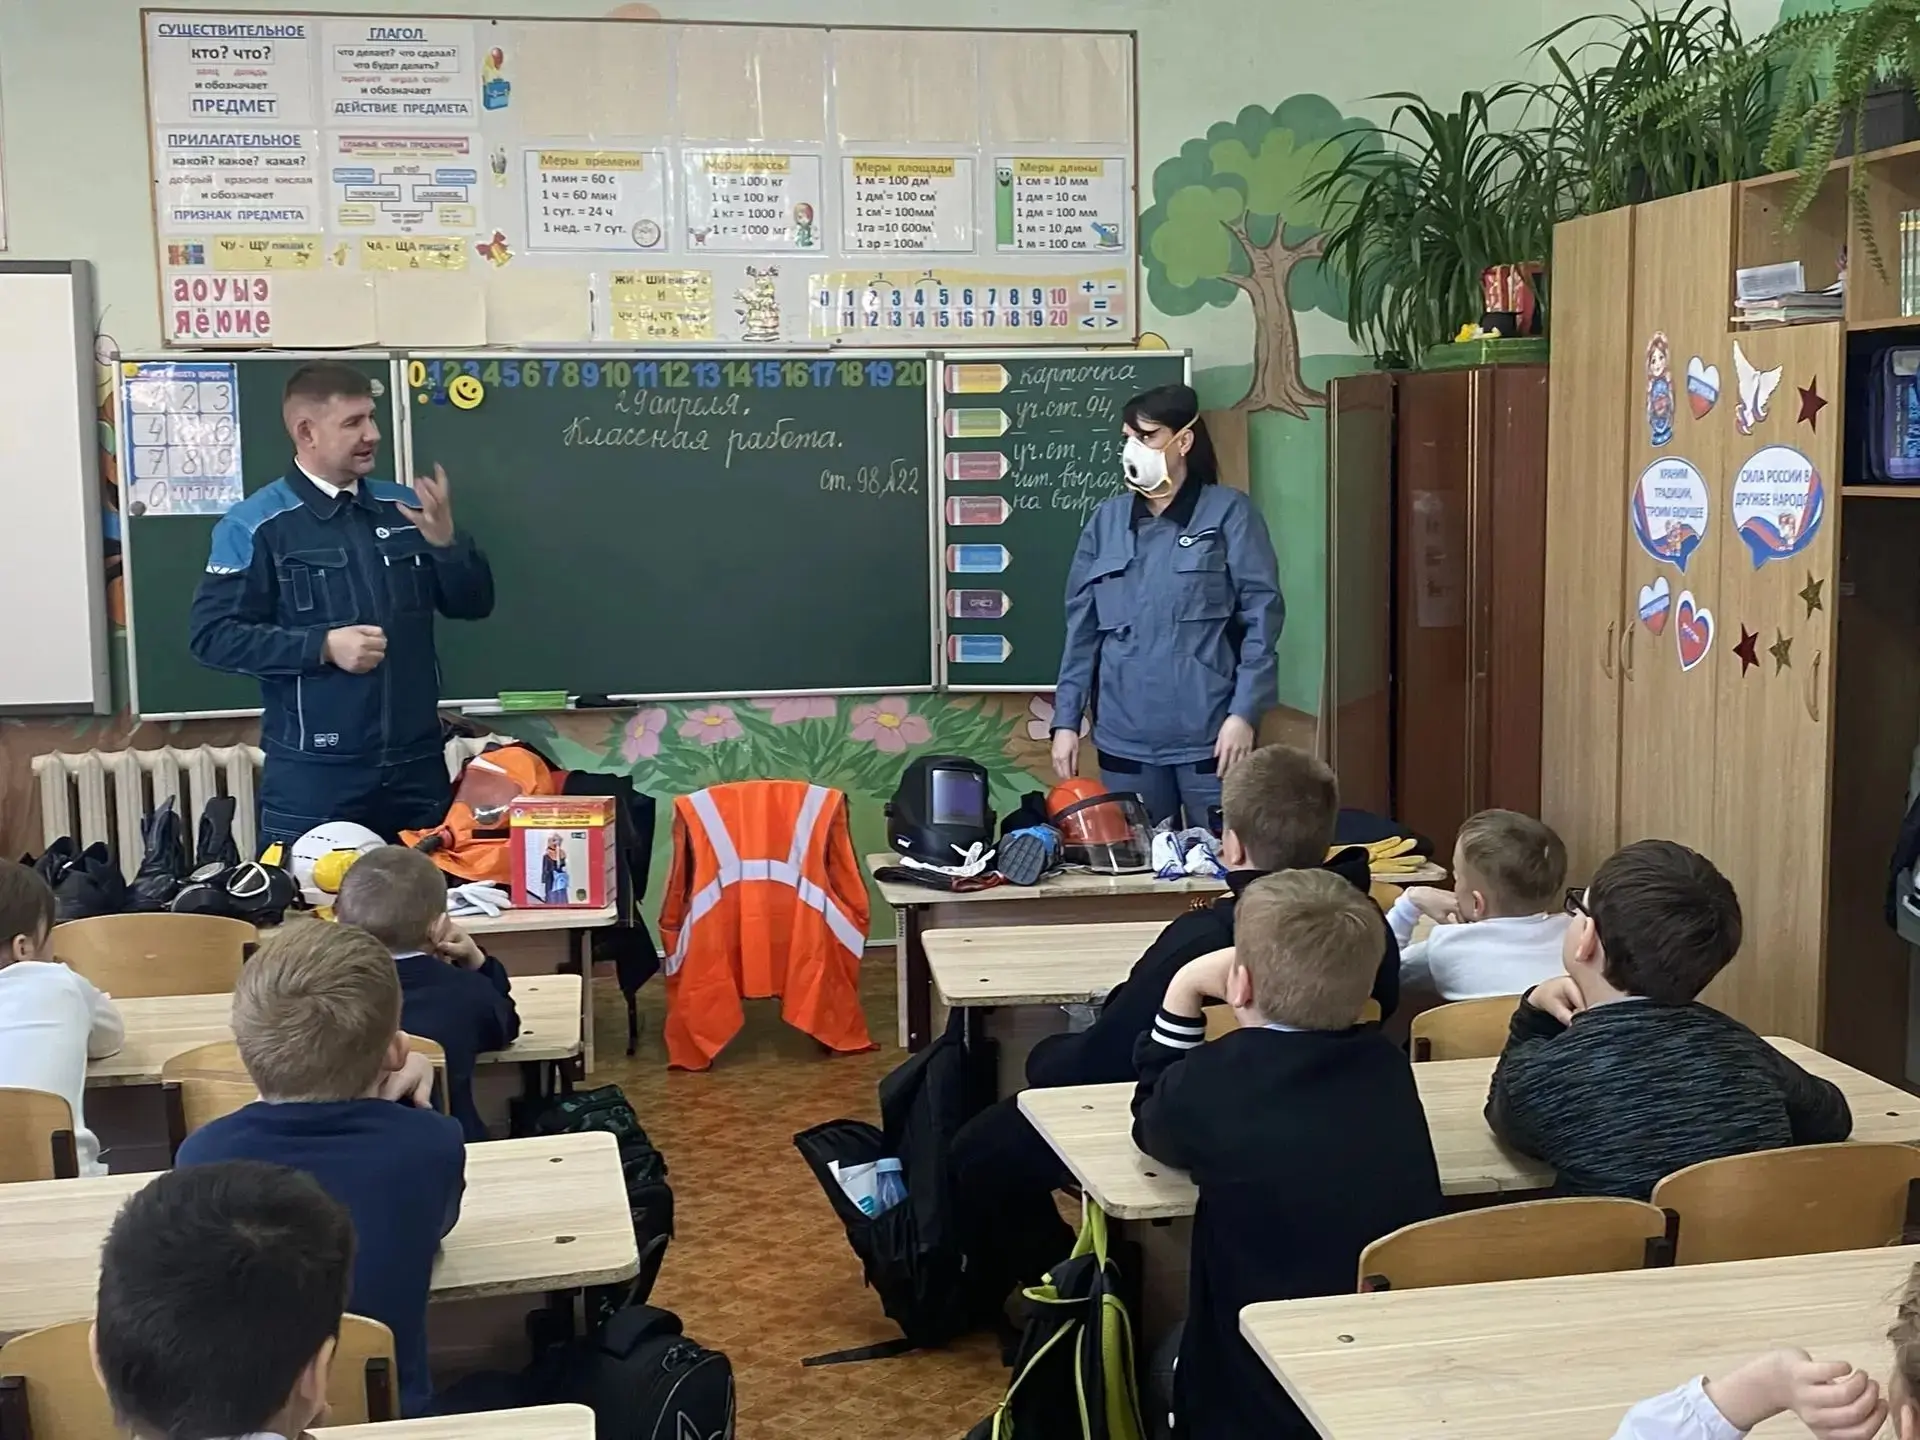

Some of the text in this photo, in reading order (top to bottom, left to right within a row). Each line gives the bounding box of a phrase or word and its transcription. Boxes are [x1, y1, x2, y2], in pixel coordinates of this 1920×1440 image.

[158, 23, 305, 38] СУЩЕСТВИТЕЛЬНОЕ
[370, 28, 423, 39] ГЛАГОЛ
[192, 46, 271, 60] кто? что?
[205, 81, 268, 90] обозначает
[370, 85, 431, 95] обозначает
[192, 99, 276, 114] ПРЕДМЕТ
[335, 102, 468, 115] ДЕЙСТВИЕ ПРЕДМЕТА
[168, 134, 300, 146] ПРИЛАГАТЕЛЬНОЕ
[173, 156, 306, 166] какой? какое? какая?
[541, 155, 579, 167] Меры
[855, 162, 892, 175] Меры
[1020, 163, 1054, 174] Меры
[542, 173, 547, 183] 1
[591, 174, 606, 183] 60
[1054, 176, 1067, 186] 10
[211, 190, 273, 200] обозначает
[542, 190, 548, 199] 1
[573, 190, 587, 200] 60
[744, 193, 764, 202] 100
[1056, 192, 1069, 202] 10
[174, 210, 303, 221] ПРИЗНАК ПРЕДМЕТА
[543, 206, 548, 215] 1
[588, 206, 602, 216] 24
[544, 223, 550, 232] 1
[594, 223, 601, 232] 7
[1049, 224, 1061, 233] 10
[221, 241, 236, 250] ЧУ
[249, 240, 269, 252] ЩУ
[367, 241, 383, 251] ЧА
[396, 241, 416, 252] ЩА
[1049, 239, 1068, 249] 100
[846, 288, 1067, 305] 1 3 4 5 6 7 8 9 10
[842, 310, 1067, 327] 11 12 13 14 15 16 17 18 19 20
[408, 360, 426, 388] 0
[483, 361, 501, 387] 4
[503, 361, 520, 388] 5
[522, 360, 541, 388] 6
[543, 361, 560, 387] 7
[562, 360, 580, 388] 8
[581, 361, 599, 387] 9
[601, 361, 631, 387] 10
[633, 361, 659, 388] 11
[660, 361, 690, 388] 12
[692, 361, 721, 387] 13
[722, 361, 753, 387] 14
[753, 361, 781, 387] 15
[782, 361, 810, 387] 16
[808, 361, 836, 387] 17
[836, 361, 865, 387] 18
[865, 361, 894, 387] 19
[895, 360, 926, 387] 20
[562, 416, 710, 448] Классная
[1741, 469, 1765, 483] СИЛА
[1767, 469, 1802, 483] РОССИИ
